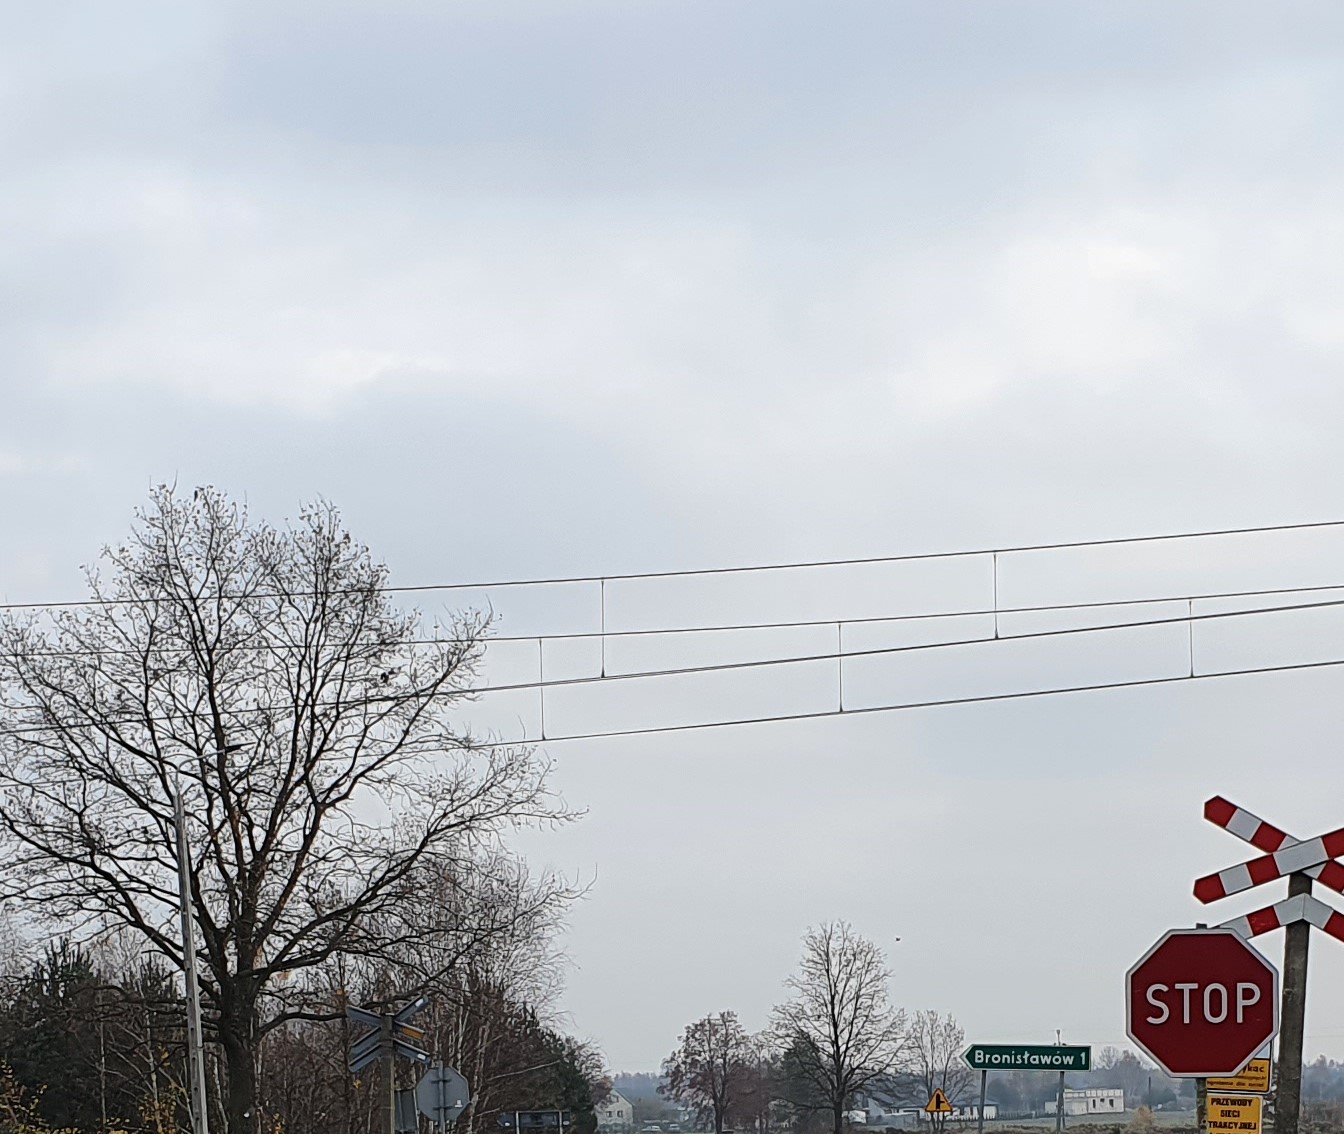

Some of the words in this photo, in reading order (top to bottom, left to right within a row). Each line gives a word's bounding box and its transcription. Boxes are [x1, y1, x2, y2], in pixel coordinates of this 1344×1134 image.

[1146, 982, 1261, 1025] STOP
[974, 1050, 1074, 1065] Bronisławów
[1079, 1052, 1086, 1065] 1
